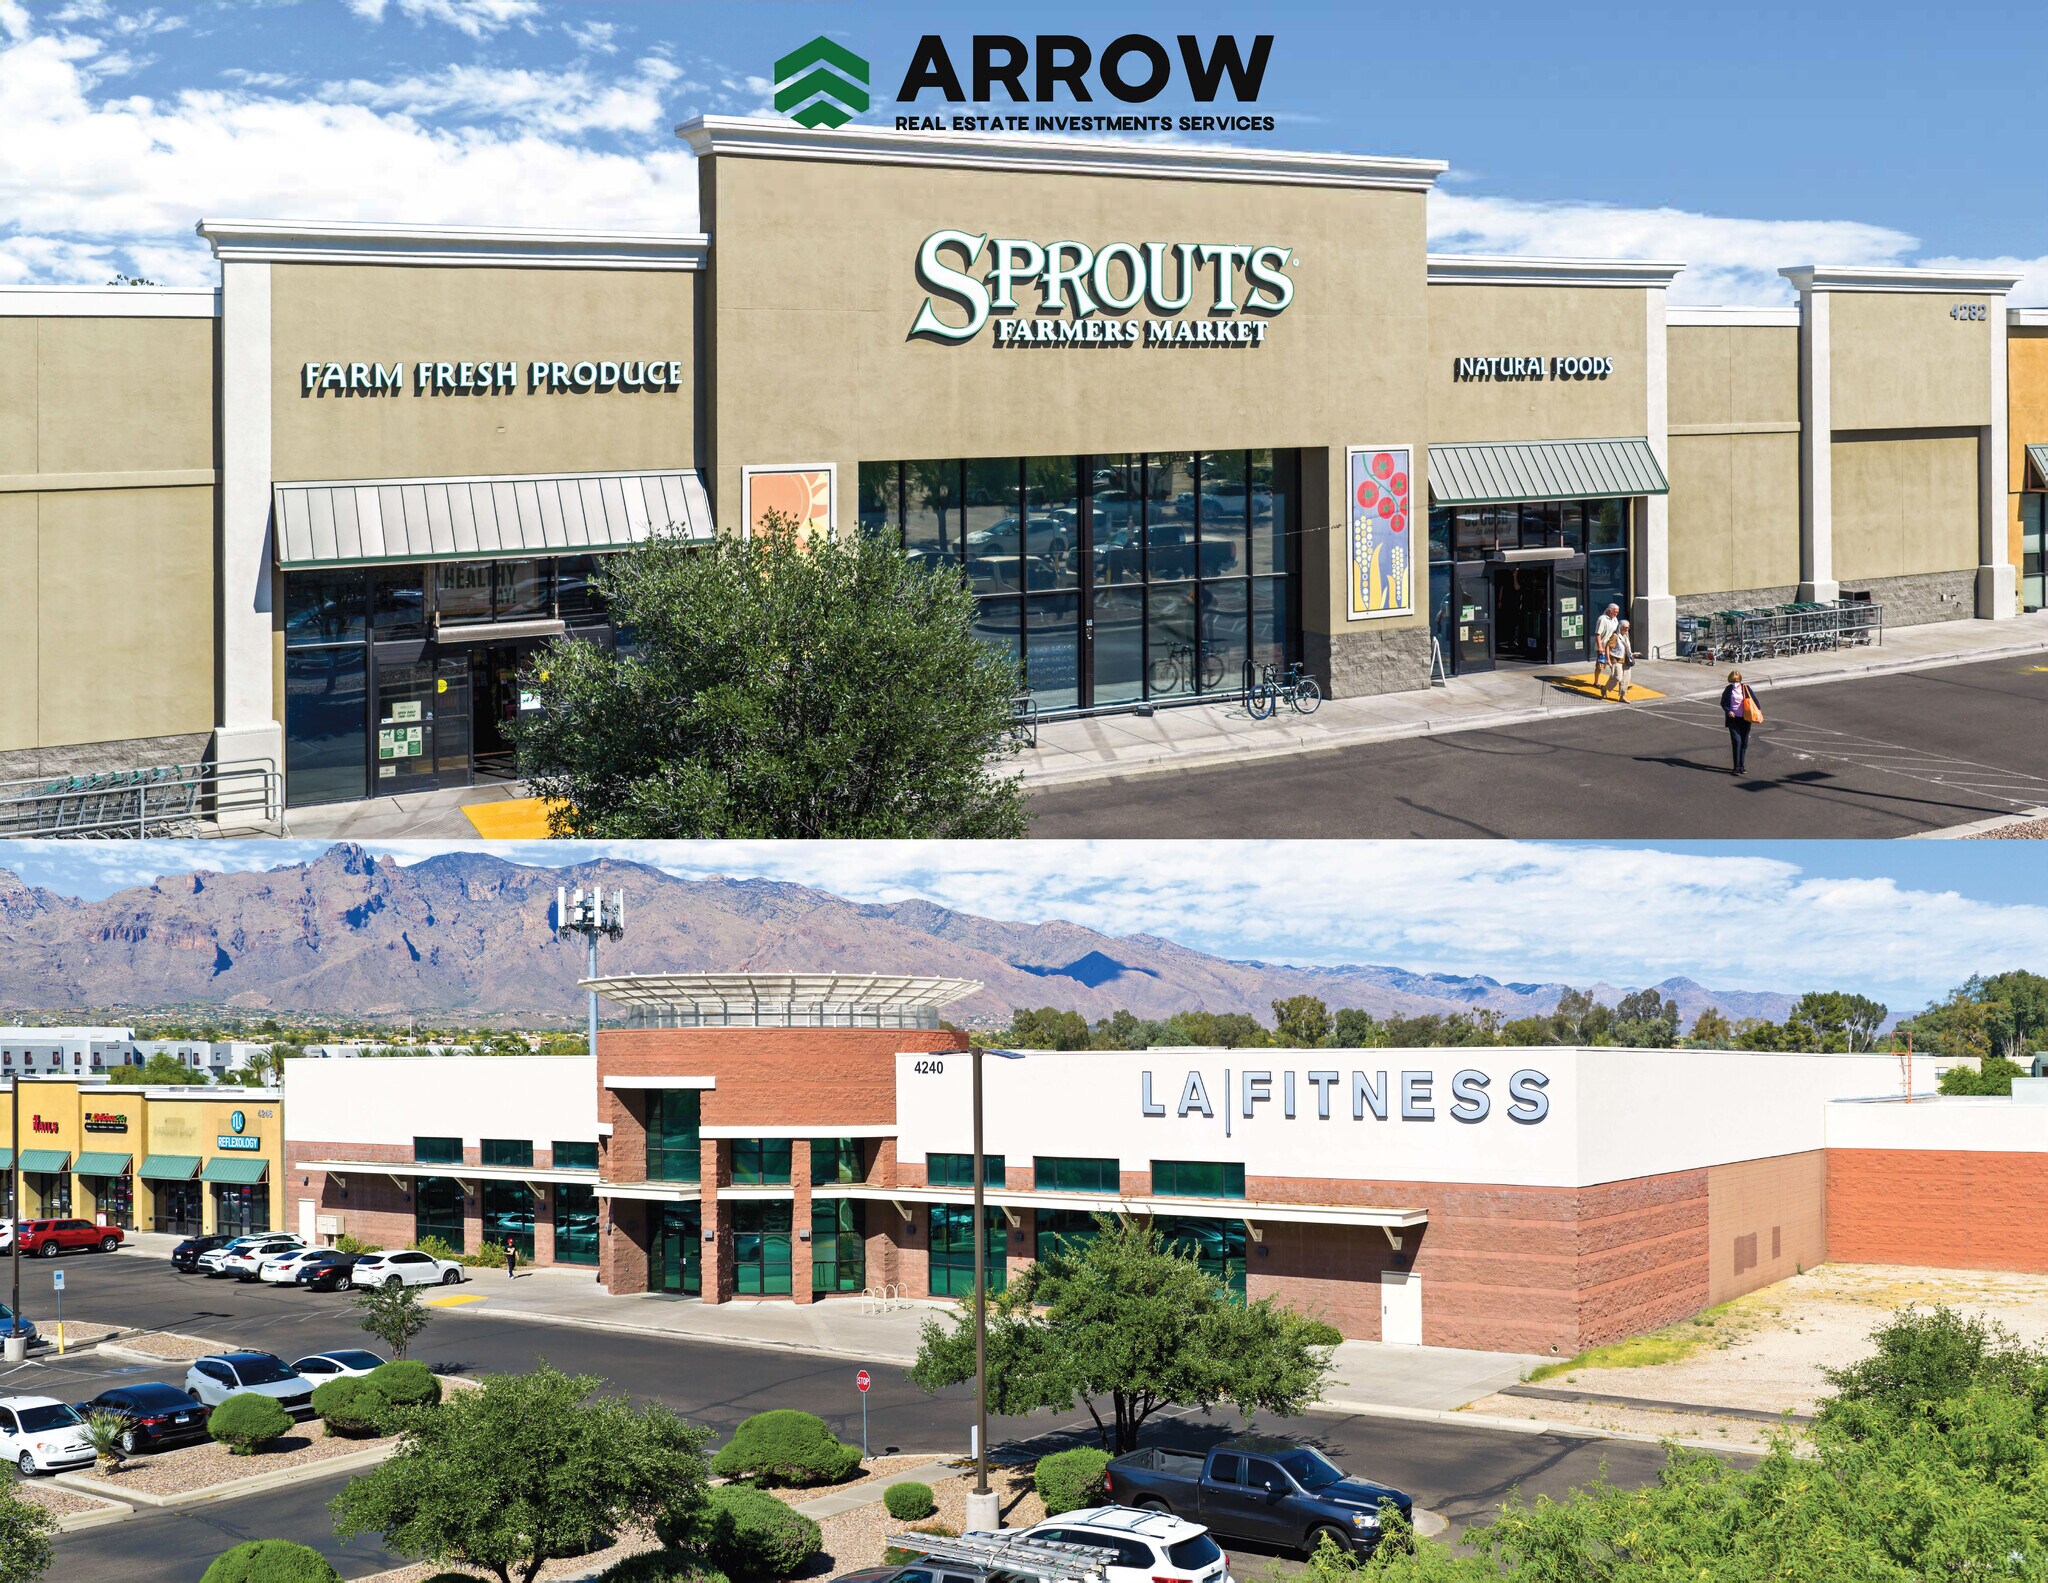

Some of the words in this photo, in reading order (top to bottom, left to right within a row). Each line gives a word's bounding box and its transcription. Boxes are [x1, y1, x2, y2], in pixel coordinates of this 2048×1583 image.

[909, 228, 1296, 342] SPROUTS
[1950, 303, 1987, 321] 4282
[996, 318, 1140, 345] FARMERS
[1147, 318, 1270, 344] MARKET
[303, 362, 405, 392] FARM
[417, 361, 519, 391] FRESH
[530, 360, 684, 389] PRODUCE
[1457, 356, 1549, 377] NATURAL
[1554, 356, 1615, 377] FOODS
[444, 563, 517, 589] HEALTHY
[914, 1061, 944, 1075] 4240
[1142, 1071, 1214, 1118] LA
[1242, 1069, 1550, 1125] FITNESS
[33, 1121, 58, 1133] NAILS
[218, 1137, 258, 1148] REFLEXOLOGY
[857, 1377, 869, 1385] STOP
